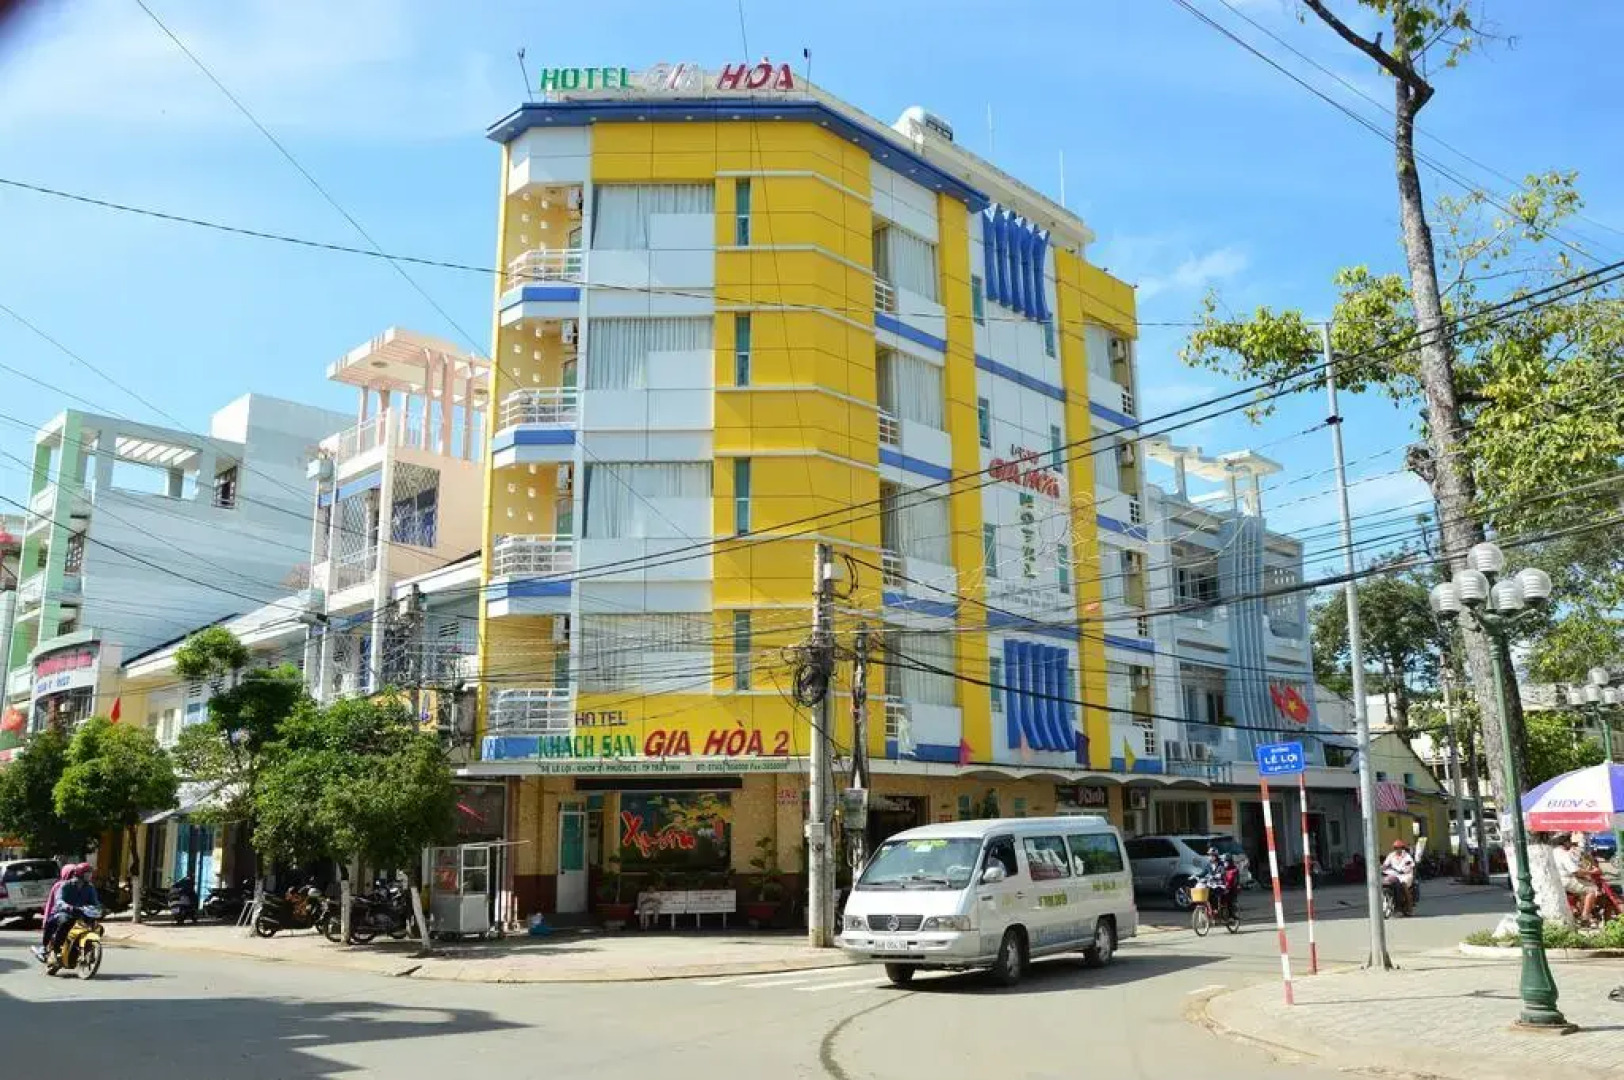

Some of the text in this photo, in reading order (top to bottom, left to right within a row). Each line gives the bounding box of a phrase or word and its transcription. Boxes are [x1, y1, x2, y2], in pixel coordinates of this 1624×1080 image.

[540, 67, 634, 89] HOTEL
[575, 711, 628, 726] HOTEL
[644, 730, 691, 756] GIA
[703, 720, 764, 756] HÒA
[773, 730, 789, 756] 2
[1547, 799, 1583, 808] BIDV
